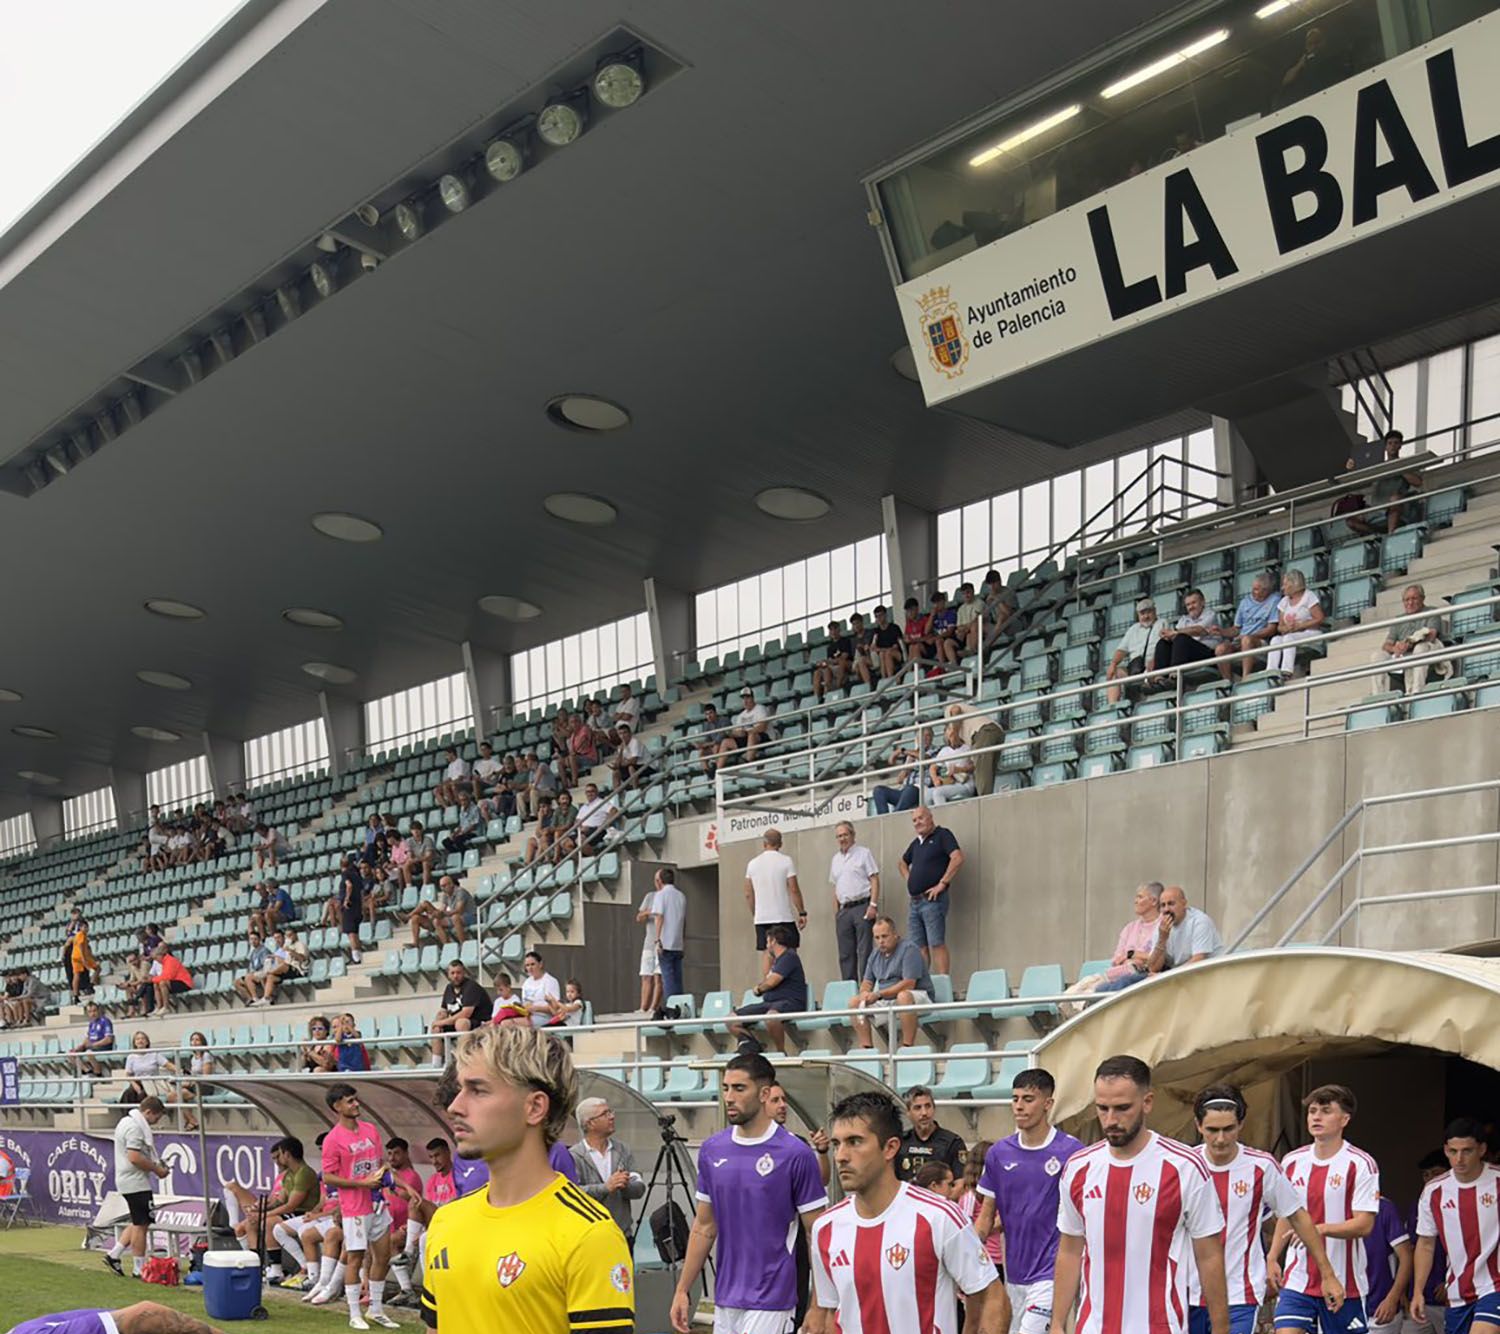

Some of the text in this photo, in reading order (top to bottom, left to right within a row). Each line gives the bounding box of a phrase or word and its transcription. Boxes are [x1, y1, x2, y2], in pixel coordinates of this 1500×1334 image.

[1086, 47, 1500, 321] LA BAL
[967, 267, 1077, 325] Ayuntamiento
[972, 299, 1066, 349] de Palencia
[730, 812, 780, 832] Patronato
[838, 798, 852, 812] de
[7, 1138, 31, 1167] BAR
[47, 1137, 107, 1172] CAFÉ BAR
[216, 1144, 279, 1190] COL
[48, 1169, 106, 1206] ORLY
